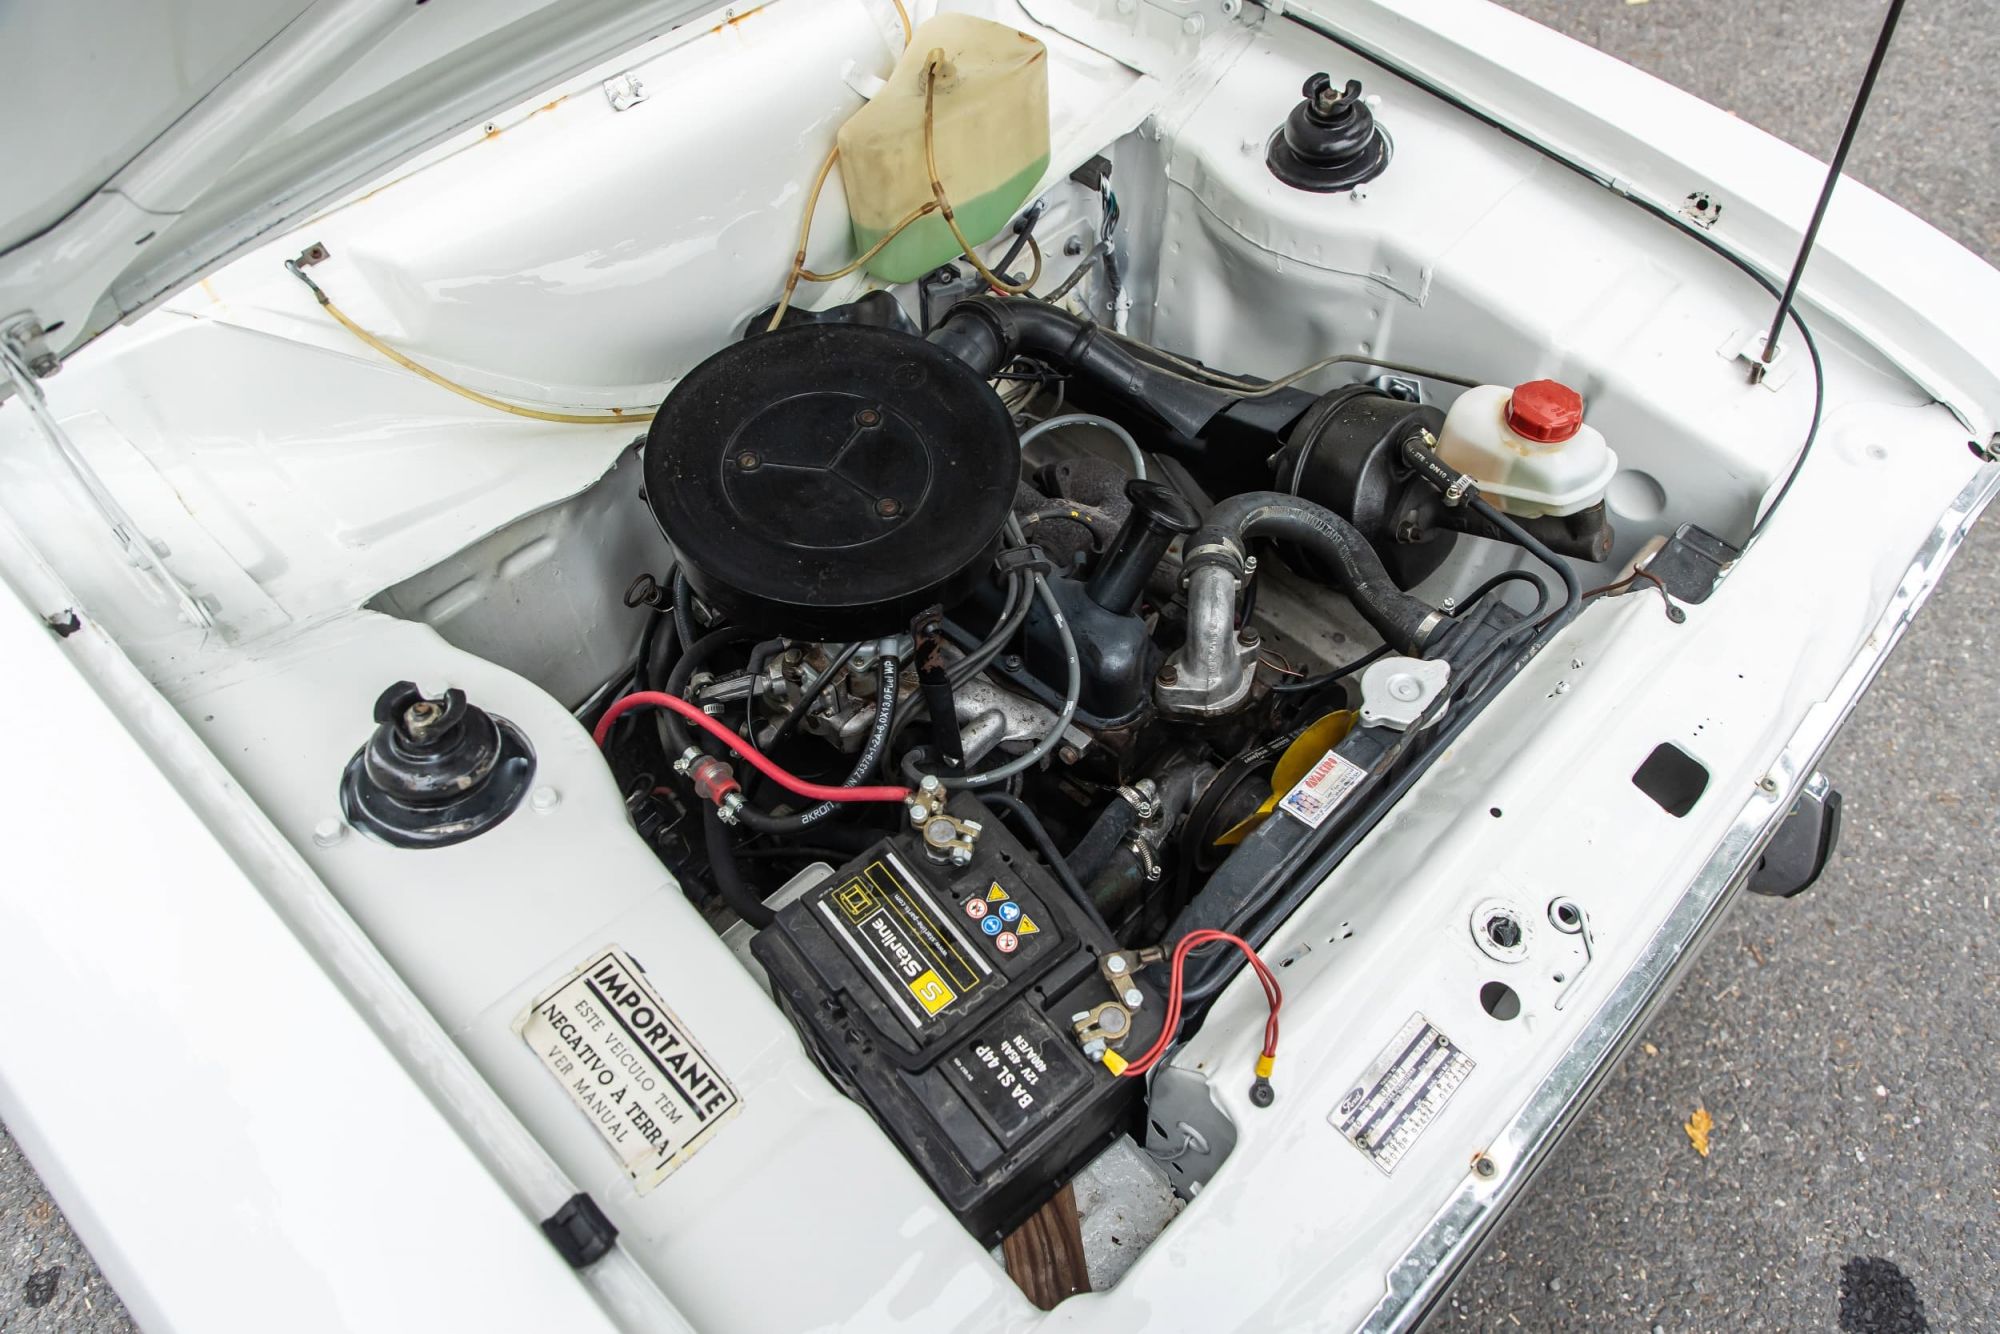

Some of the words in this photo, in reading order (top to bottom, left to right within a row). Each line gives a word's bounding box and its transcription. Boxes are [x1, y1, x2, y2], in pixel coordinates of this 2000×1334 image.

[885, 660, 893, 675] WP
[872, 917, 923, 978] Starline
[593, 963, 727, 1115] IMPORTANTE
[998, 1039, 1022, 1065] 45Ah
[575, 1000, 606, 1032] ESTE
[655, 1093, 683, 1124] TEM
[975, 1044, 1000, 1069] 44P
[1012, 1034, 1048, 1073] 400A/EN
[542, 1004, 615, 1085] NEGATIVO
[626, 1101, 670, 1157] TERRA
[994, 1064, 1016, 1088] SL
[1020, 1065, 1039, 1086] 12V
[547, 1045, 573, 1076] VER
[573, 1078, 628, 1143] MANUAL
[1009, 1082, 1034, 1108] BA
[1342, 1090, 1361, 1114] Ford
